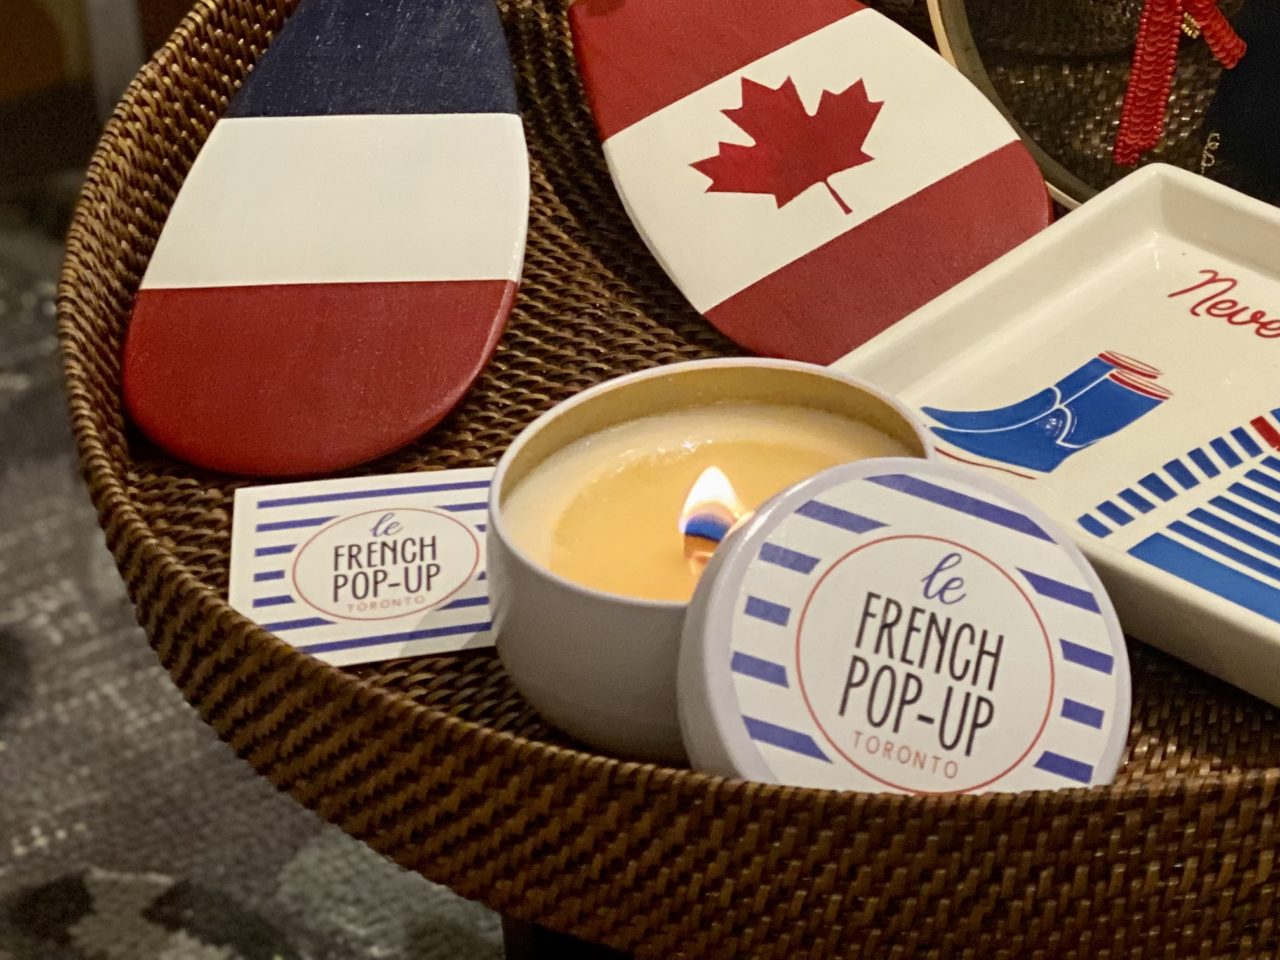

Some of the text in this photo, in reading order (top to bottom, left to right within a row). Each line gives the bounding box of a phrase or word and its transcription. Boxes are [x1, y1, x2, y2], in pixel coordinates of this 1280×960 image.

[371, 512, 402, 537] le
[334, 536, 436, 572] FRENCH
[332, 563, 441, 603] POP-UP
[920, 552, 967, 605] le
[347, 595, 425, 613] TORONTO
[854, 591, 1004, 691] FRENCH
[838, 655, 995, 757] POP-UP
[853, 731, 958, 779] TORONTO
